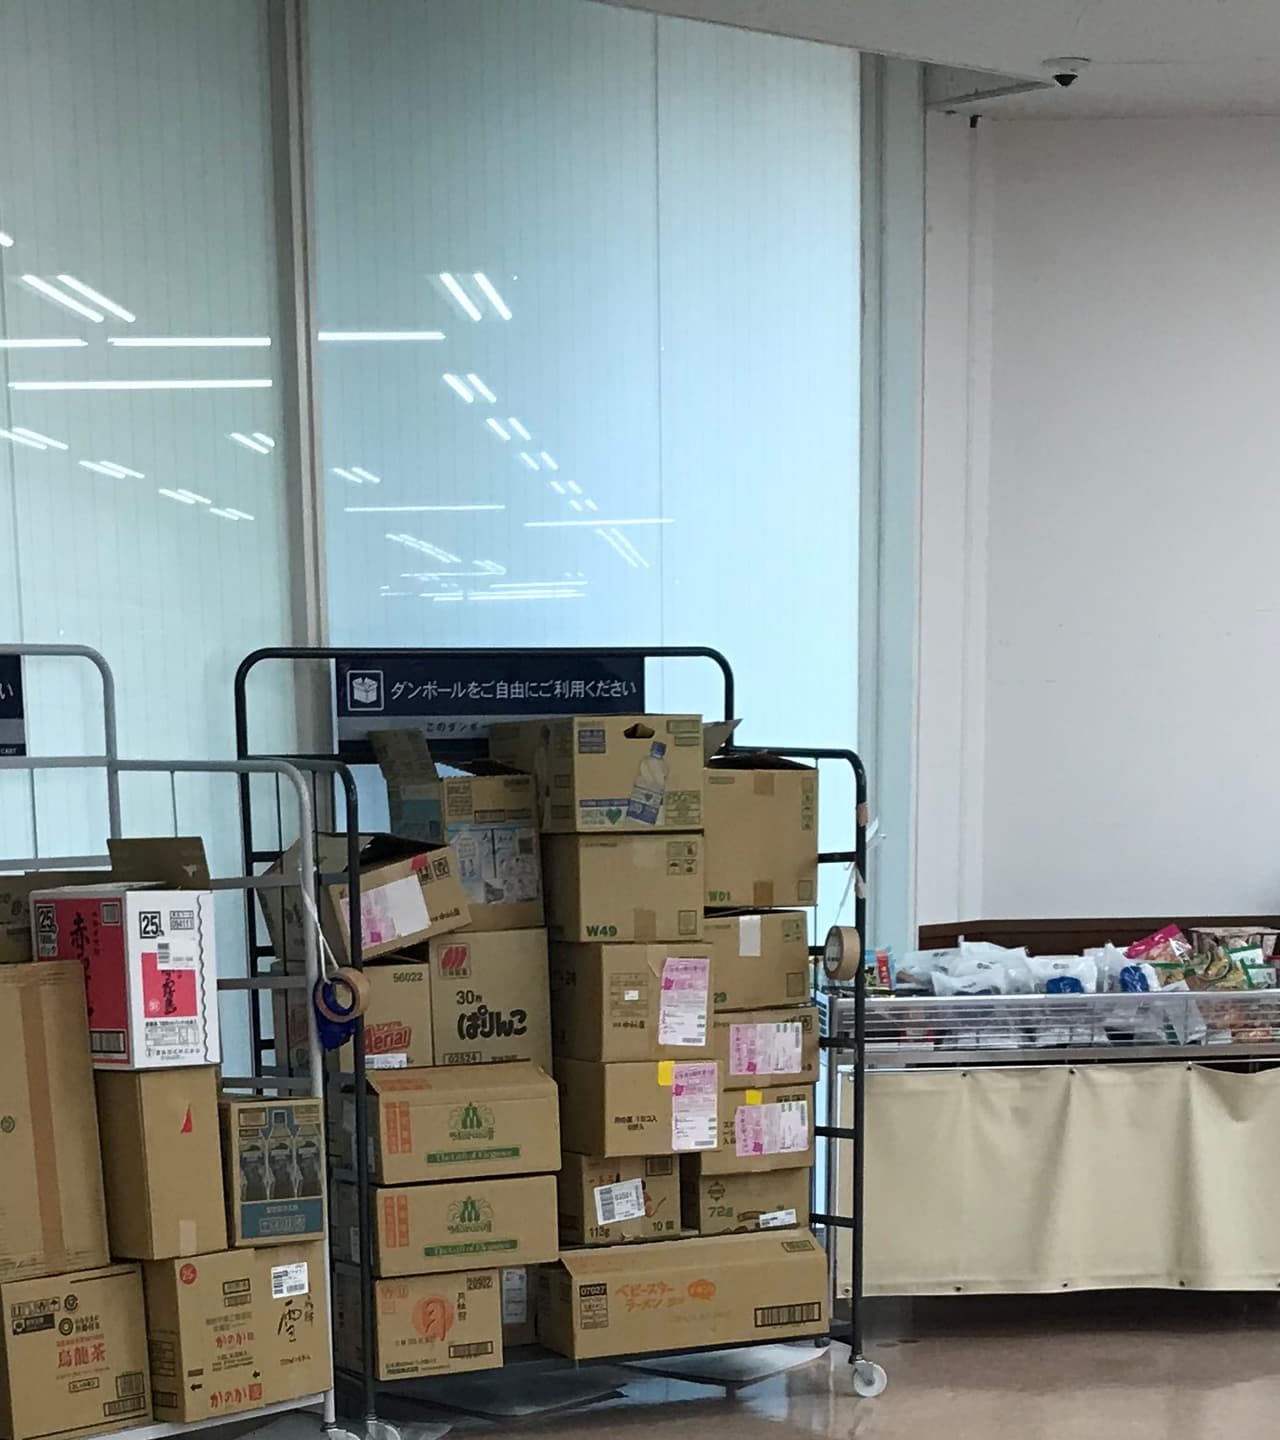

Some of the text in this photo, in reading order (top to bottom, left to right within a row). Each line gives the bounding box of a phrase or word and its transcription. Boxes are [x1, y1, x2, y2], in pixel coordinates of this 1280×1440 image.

[391, 680, 636, 700] ダンボールをご自由にご利用ください
[586, 926, 617, 937] W49
[458, 1005, 528, 1041] ぱりんこ
[616, 1281, 675, 1297] ベビースター
